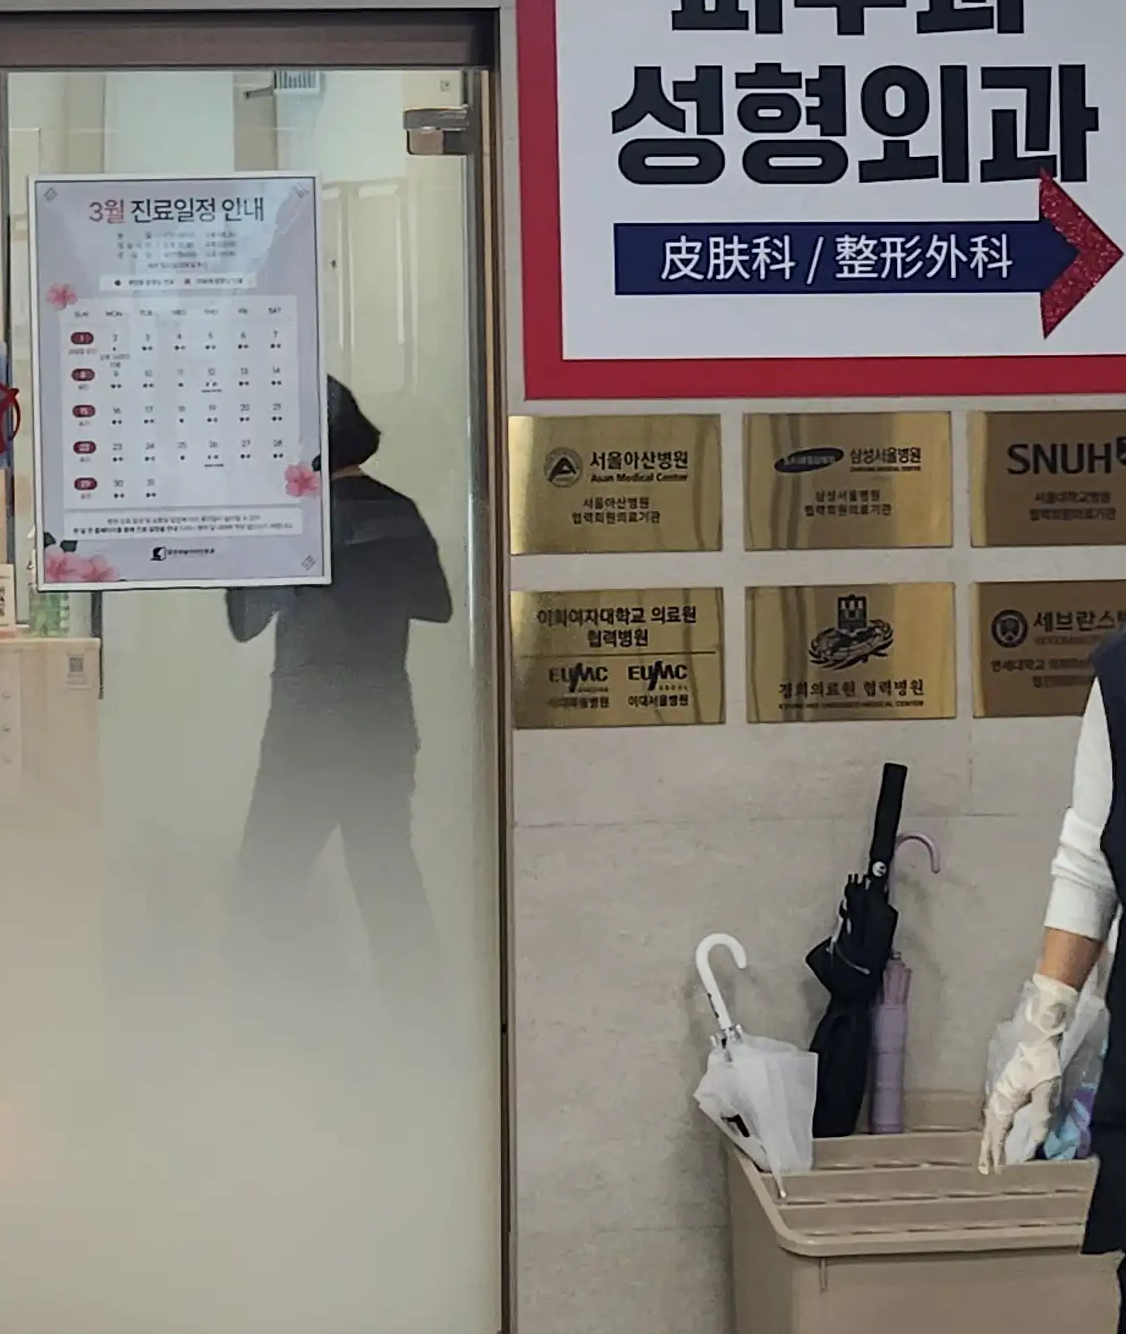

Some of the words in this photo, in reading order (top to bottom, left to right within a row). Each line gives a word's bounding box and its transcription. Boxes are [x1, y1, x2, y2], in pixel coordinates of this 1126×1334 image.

[611, 62, 1099, 185] 성형외과
[89, 199, 126, 224] 3월
[131, 197, 216, 223] 진료일정
[222, 197, 264, 222] 안내
[660, 234, 795, 281] 皮肤科
[834, 233, 1013, 280] 整形外科
[590, 451, 689, 471] 서울아산병원
[850, 447, 922, 464] 삼성서울병원
[1006, 443, 1112, 475] SNUH
[616, 473, 654, 482] Medical
[537, 607, 647, 628] 이화여자대학교
[651, 606, 696, 624] 의료원
[587, 629, 649, 648] 협력병원
[863, 679, 925, 698] 협력병원
